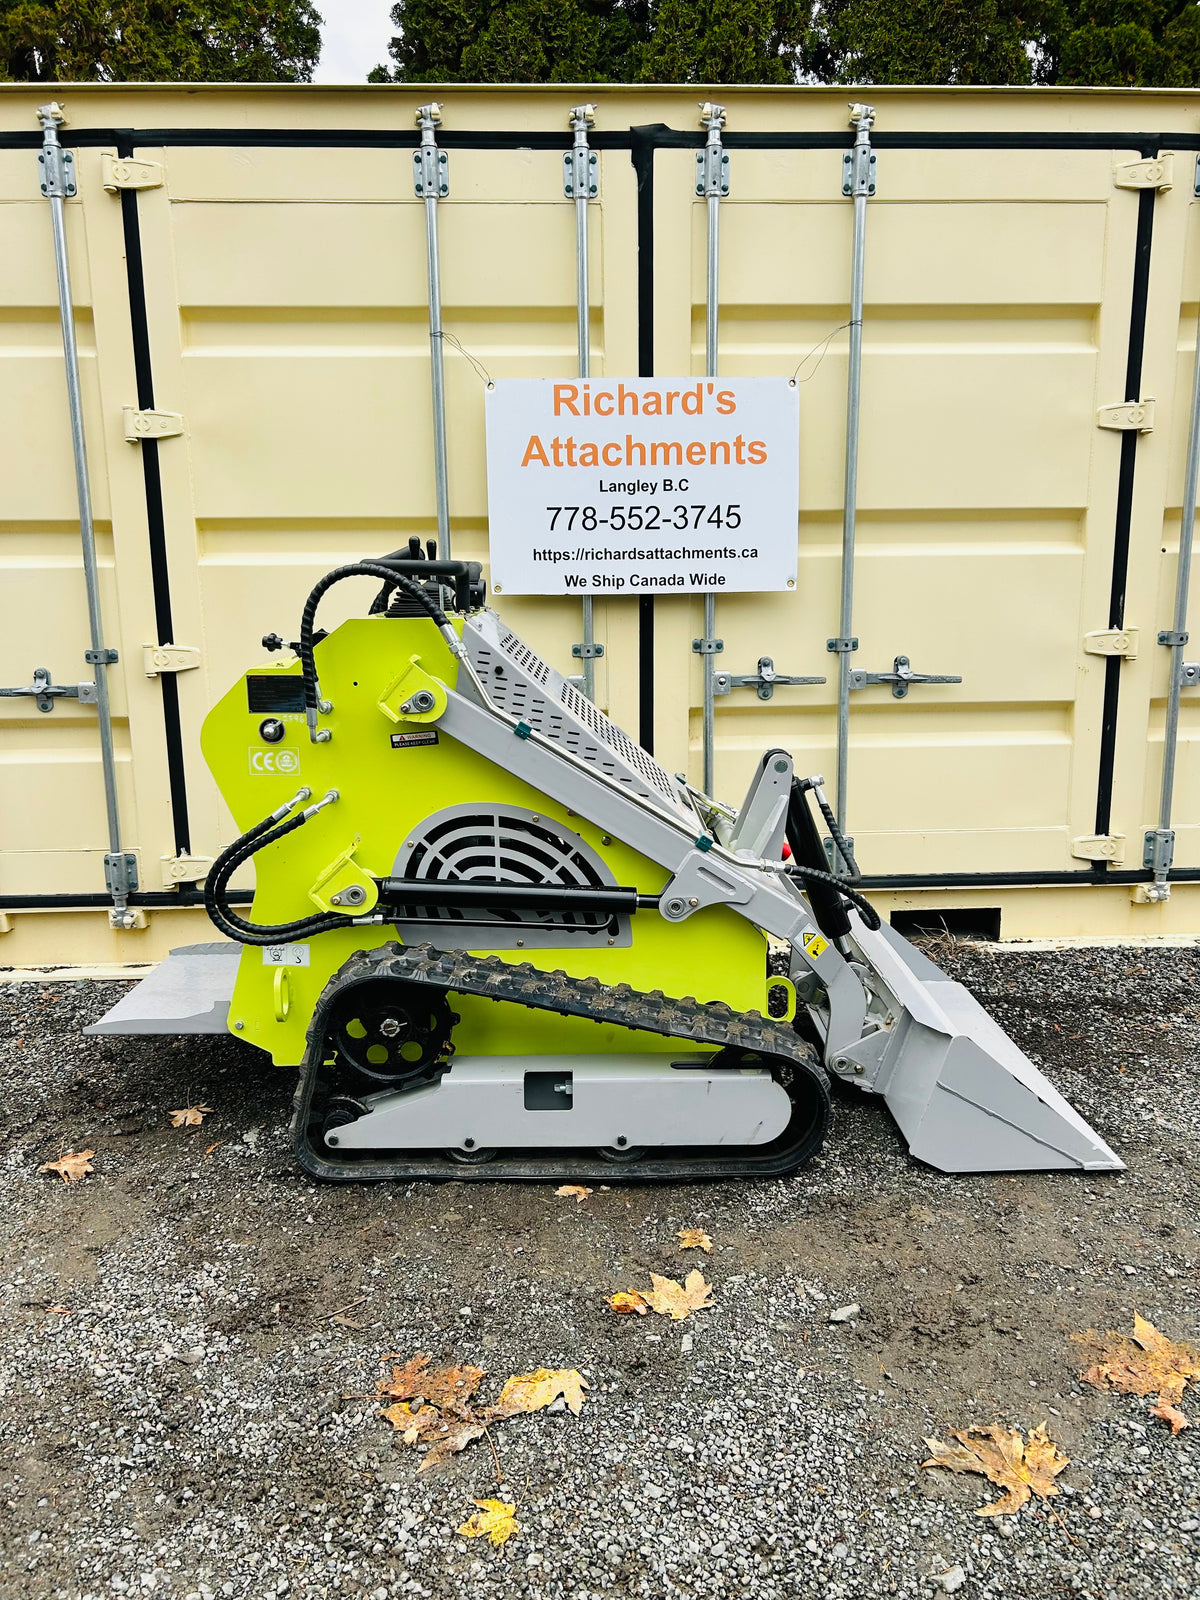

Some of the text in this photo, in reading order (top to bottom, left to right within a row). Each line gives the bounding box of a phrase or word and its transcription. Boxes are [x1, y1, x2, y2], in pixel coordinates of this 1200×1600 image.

[553, 383, 737, 416] Richard's
[520, 434, 768, 467] Attachments
[599, 478, 690, 495] Langley B.C
[546, 505, 742, 531] 778-552-3745
[533, 547, 759, 564] https://richardsattachments.ca
[564, 573, 726, 590] We Ship Canada Wide
